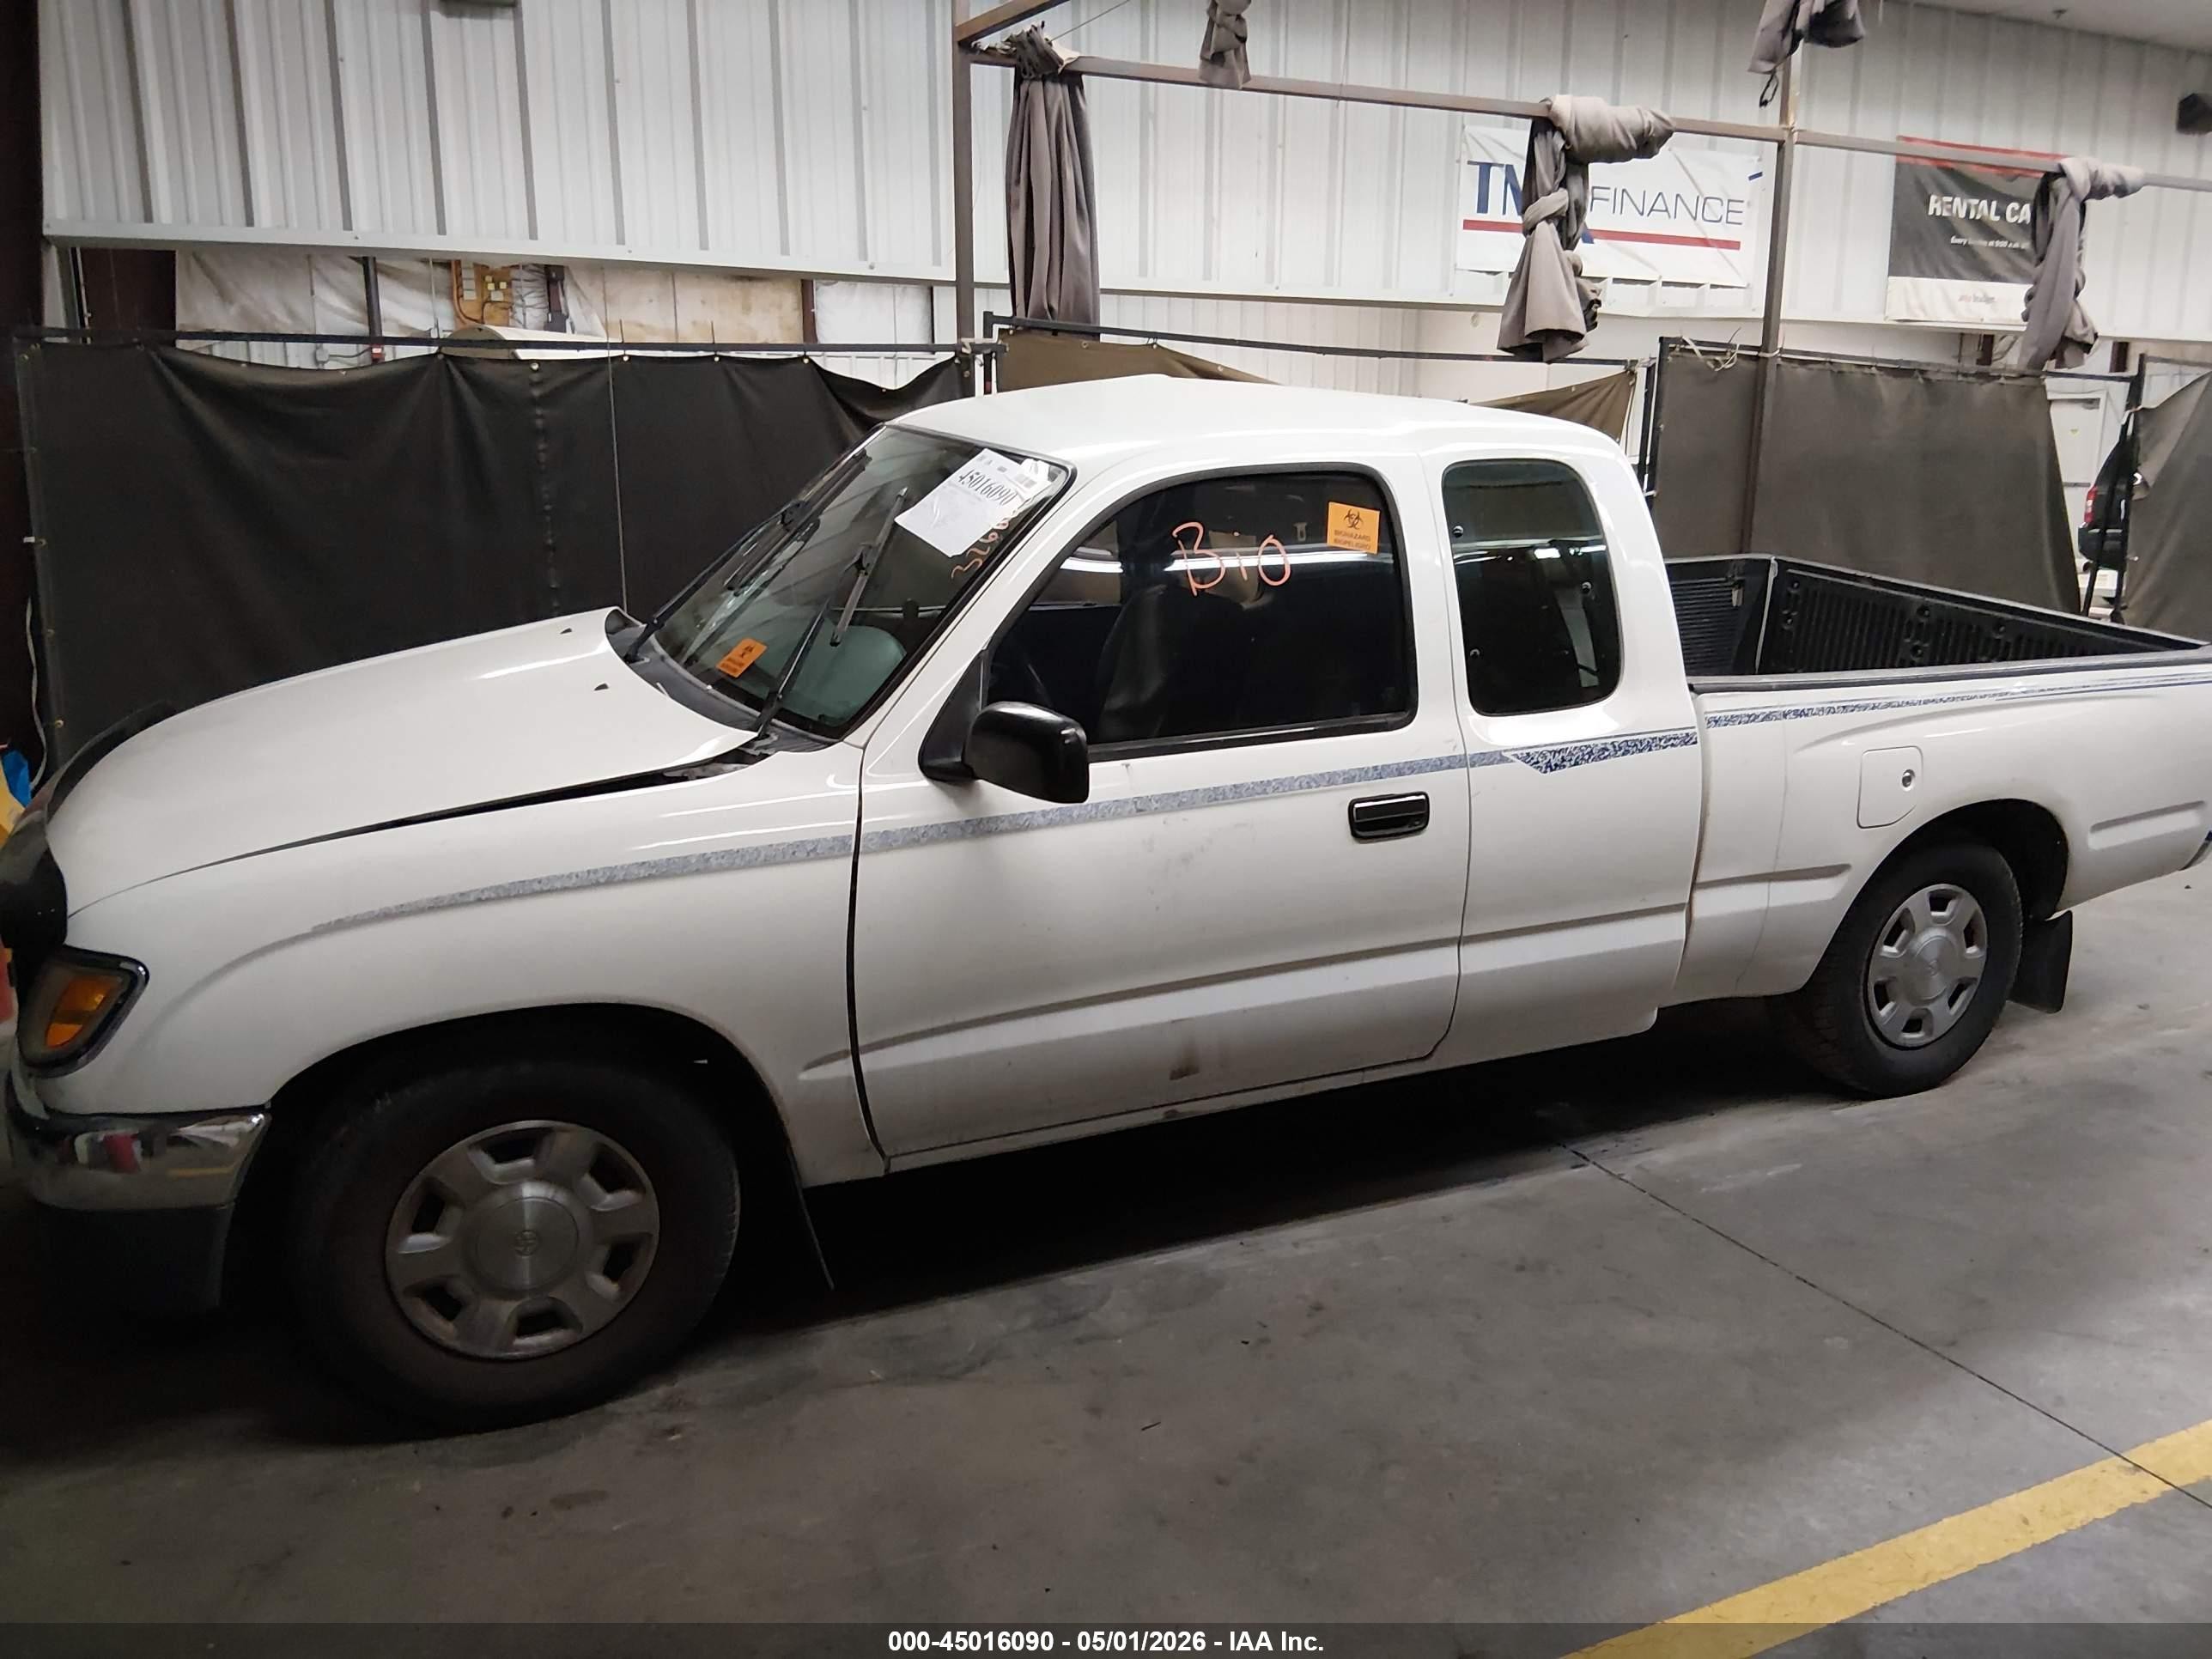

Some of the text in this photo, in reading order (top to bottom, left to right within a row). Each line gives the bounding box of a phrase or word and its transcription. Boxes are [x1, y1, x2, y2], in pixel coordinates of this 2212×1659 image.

[1589, 185, 1745, 226] FINANCE
[1928, 194, 2032, 225] RENTAL CA
[958, 469, 1018, 507] 45016090
